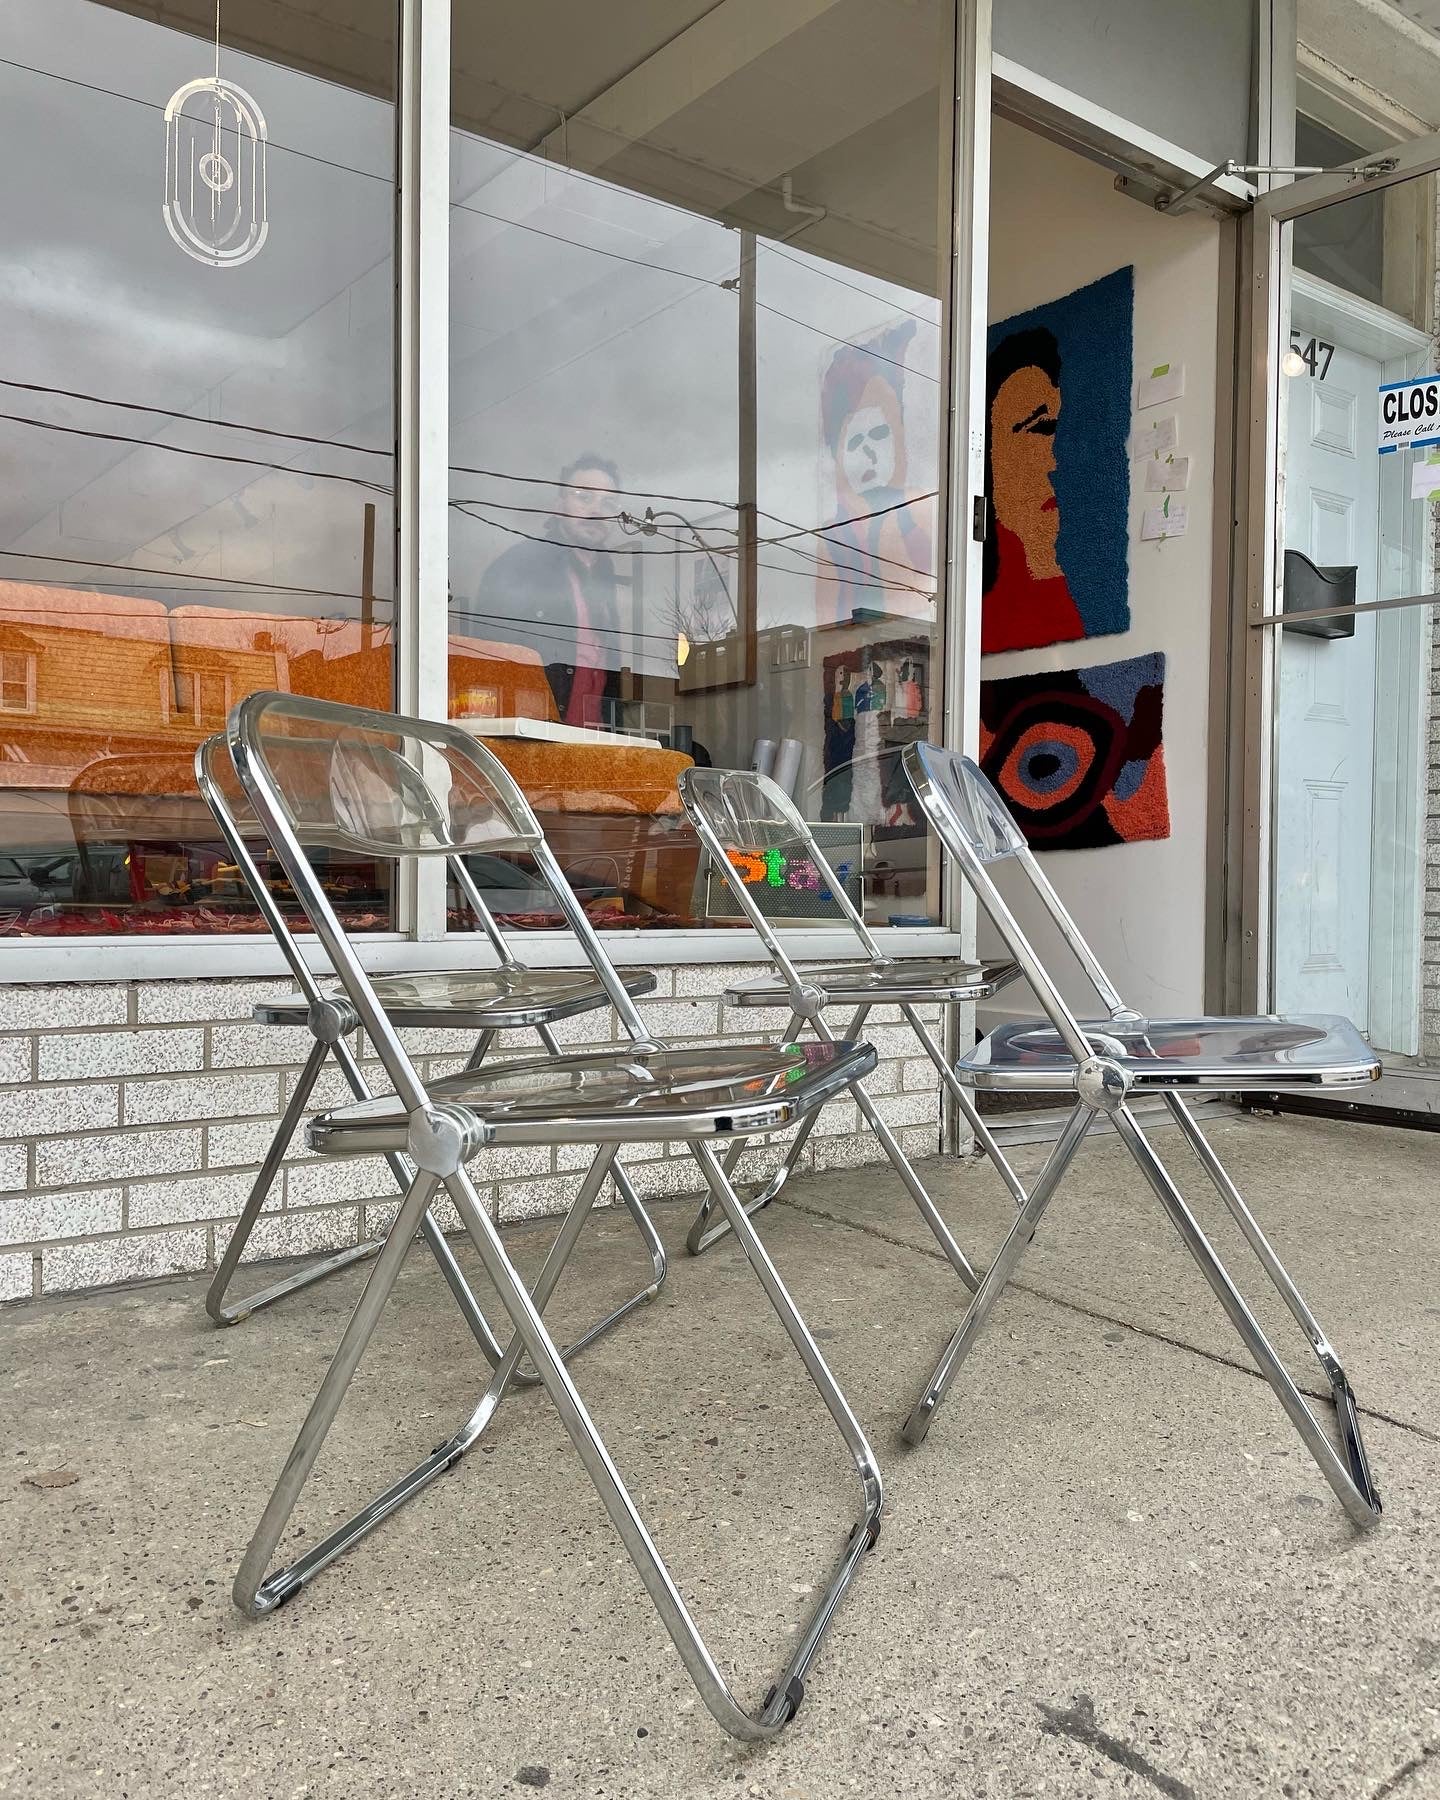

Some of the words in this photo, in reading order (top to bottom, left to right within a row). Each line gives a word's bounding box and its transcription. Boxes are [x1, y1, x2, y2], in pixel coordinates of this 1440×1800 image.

[1383, 385, 1440, 424] CLOS
[1383, 430, 1411, 440] Please
[1414, 423, 1434, 435] Call
